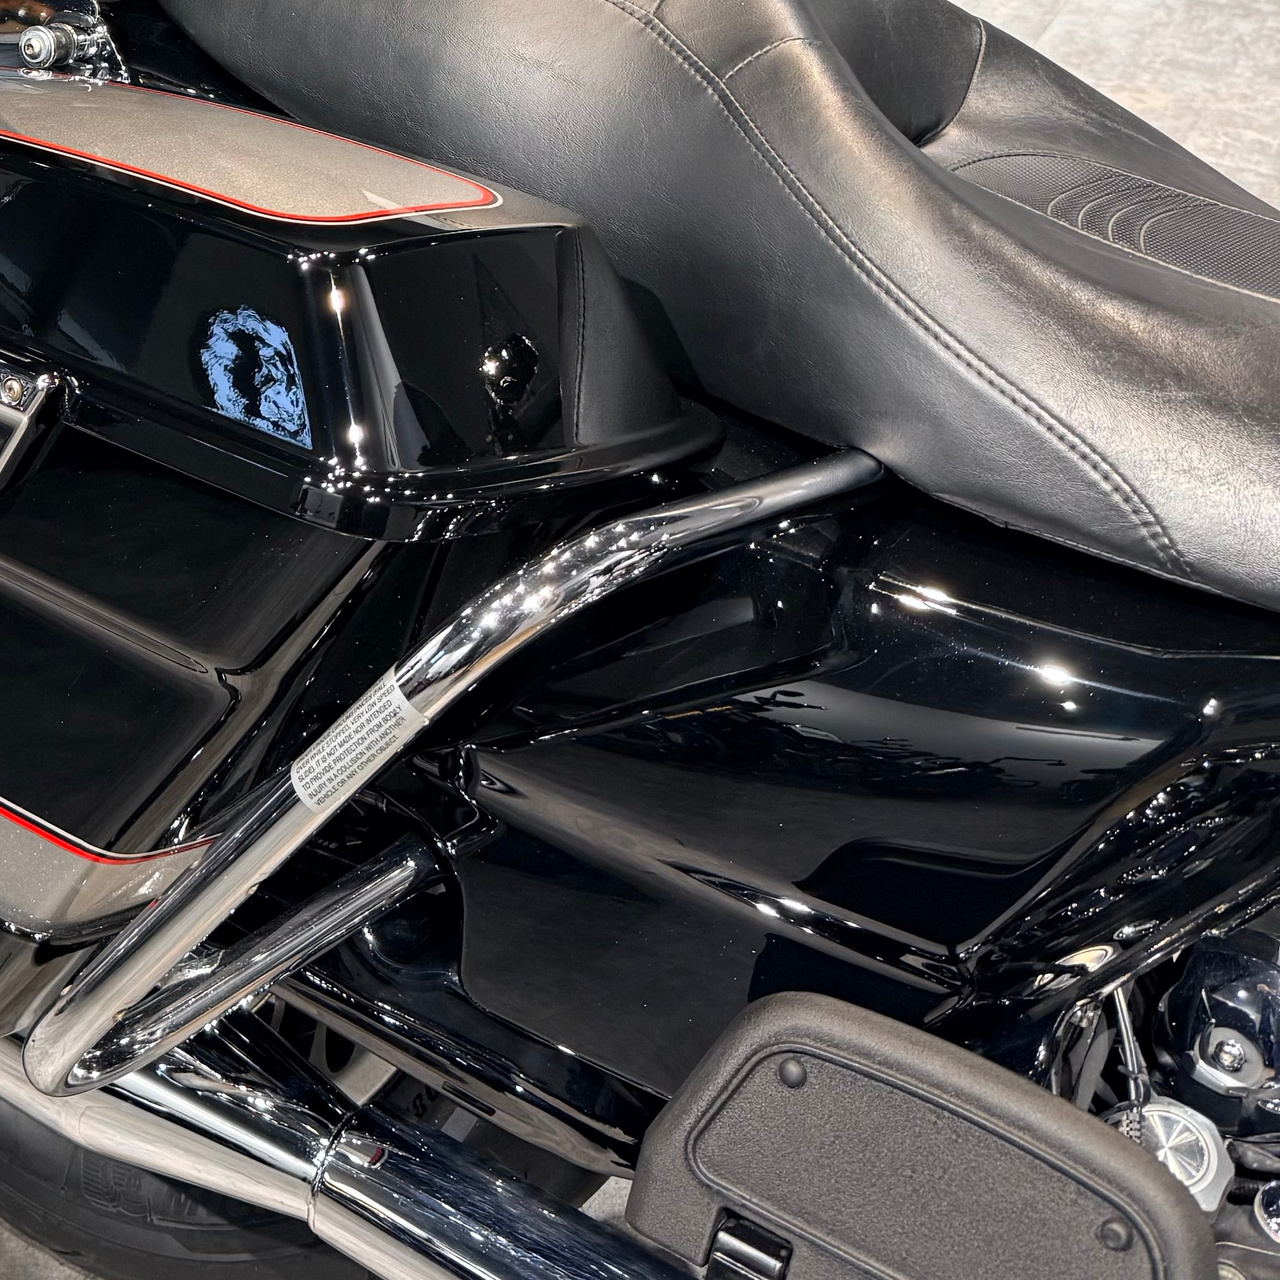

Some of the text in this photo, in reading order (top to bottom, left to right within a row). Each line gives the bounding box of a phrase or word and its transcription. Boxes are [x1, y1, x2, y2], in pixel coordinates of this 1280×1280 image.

[295, 757, 310, 774] OVER
[309, 743, 325, 761] WHILE
[350, 709, 364, 725] VERY
[363, 698, 377, 714] LOW
[375, 683, 395, 703] SPEED
[301, 780, 311, 791] TO
[308, 761, 334, 785] PROVIDE
[331, 733, 367, 766] PROTECTION
[365, 720, 383, 738] FROM
[306, 780, 328, 800] INJURY
[325, 775, 334, 784] IN
[335, 748, 366, 776] COLLISION
[363, 736, 380, 753] WITH
[377, 714, 406, 741] ANOTHER
[314, 758, 321, 768] IT
[319, 753, 328, 763] IS
[326, 744, 338, 758] NOT
[336, 731, 354, 749] MADE
[352, 721, 366, 736] NOR
[364, 698, 393, 725] INTENDED
[313, 732, 399, 806] VEHICLE OR ANY OTHER OBJECT.
